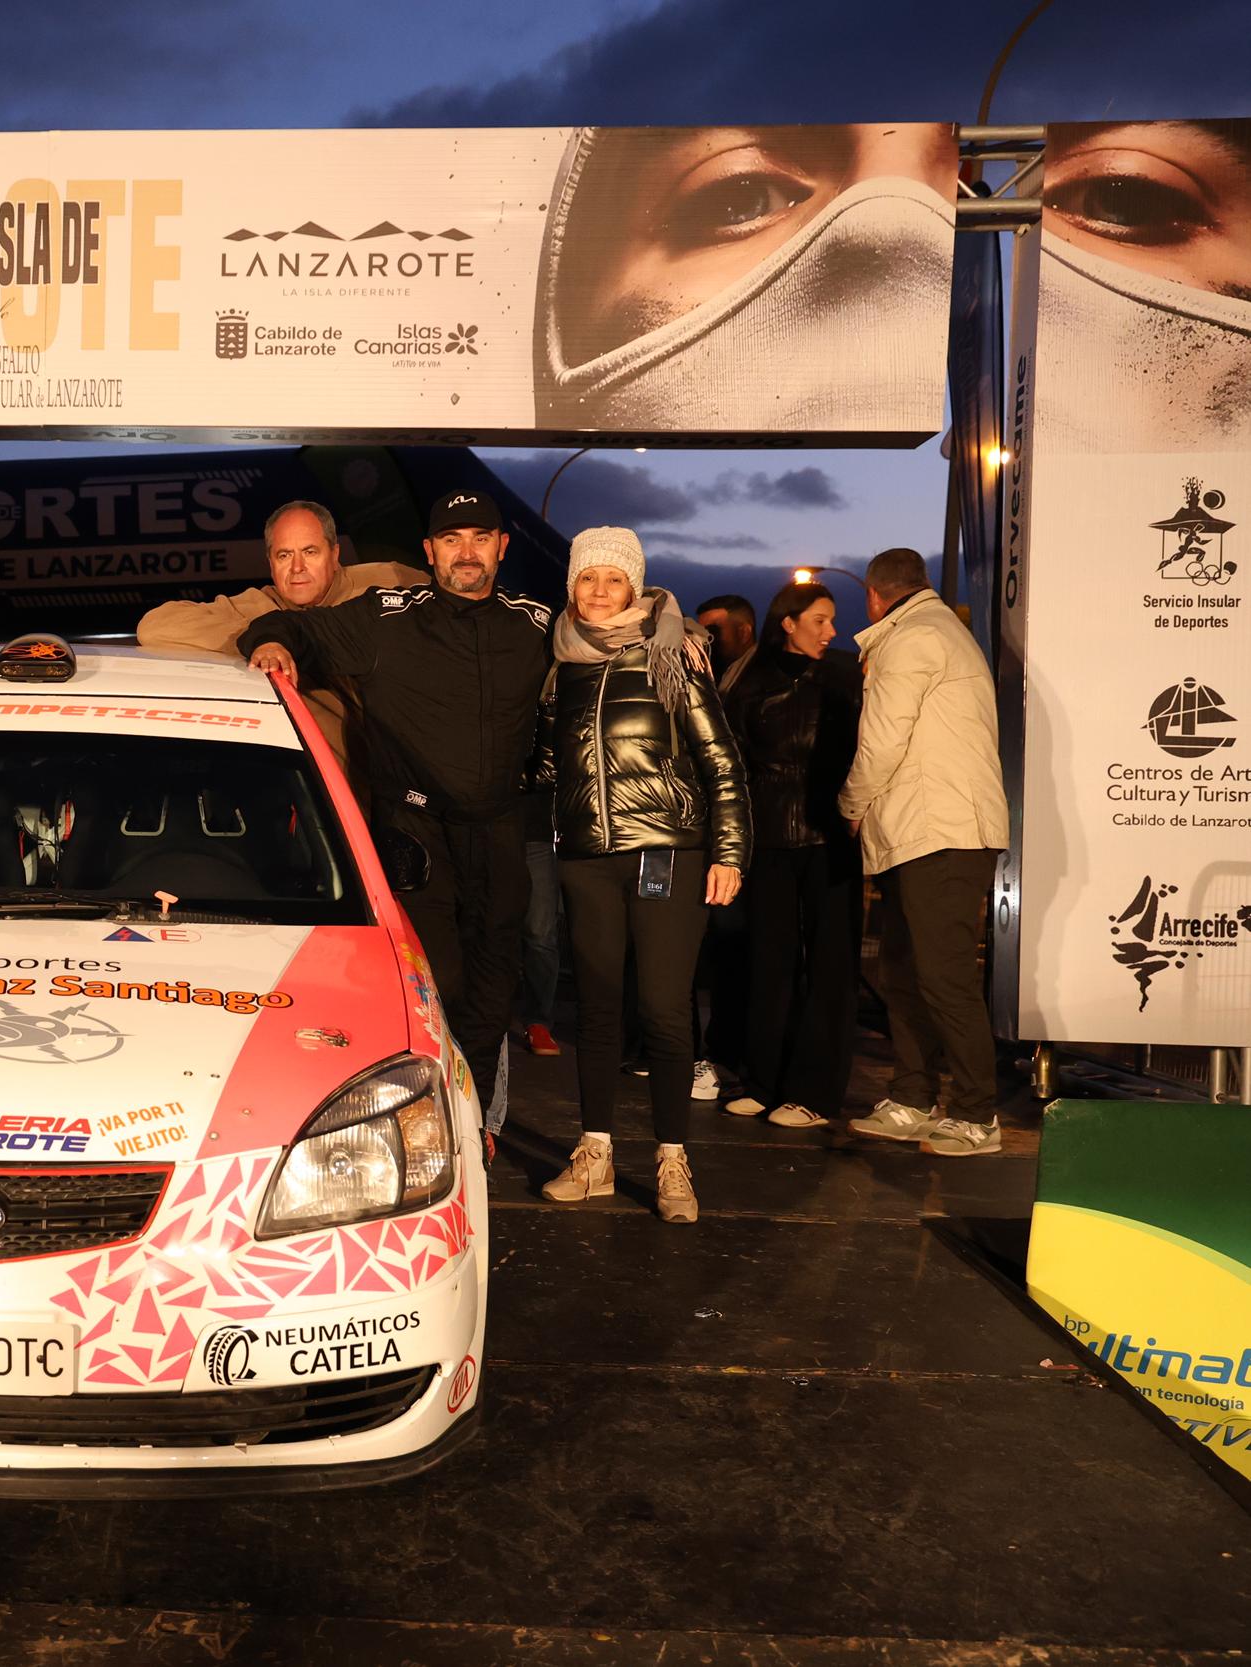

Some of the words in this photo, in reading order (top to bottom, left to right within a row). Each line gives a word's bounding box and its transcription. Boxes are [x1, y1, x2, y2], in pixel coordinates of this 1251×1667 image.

[62, 200, 100, 285] DE
[221, 251, 475, 277] LANZAROTE
[282, 288, 298, 297] LA
[304, 288, 333, 297] ISLA
[339, 288, 412, 297] DIFERENTE
[255, 325, 317, 340] Cabildo
[322, 325, 343, 340] de
[397, 323, 442, 339] Islas
[254, 341, 337, 356] Lanzarote
[353, 339, 442, 355] Canarias
[35, 382, 45, 408] de
[46, 378, 124, 409] LANZAROTE
[1005, 354, 1028, 609] Orvecame
[28, 549, 228, 580] LANZAROTE
[382, 596, 404, 606] OMP
[1143, 594, 1194, 608] Servicio
[1197, 594, 1242, 608] Insular
[1154, 615, 1170, 628] de
[1173, 615, 1229, 631] Deportes
[1107, 763, 1183, 780] Centros
[1190, 765, 1214, 781] de
[406, 792, 427, 806] OMP
[1106, 784, 1177, 802] Cultura
[1179, 790, 1190, 807] y
[1112, 813, 1166, 827] Cabildo
[1170, 814, 1188, 827] de
[160, 929, 190, 942] E
[1159, 912, 1238, 938] Arrecife
[1195, 939, 1205, 947] de
[49, 974, 295, 1015] Santiago
[96, 1114, 126, 1137] ¡VA
[128, 1106, 165, 1128] POR
[164, 1101, 184, 1119] TI
[113, 1125, 189, 1157] VIEJITO!
[265, 1310, 421, 1347] NEUMÁTICOS
[1064, 1315, 1091, 1335] bp
[289, 1337, 402, 1376] CATELA
[451, 1364, 469, 1404] KIA
[1157, 1388, 1244, 1411] tecnología
